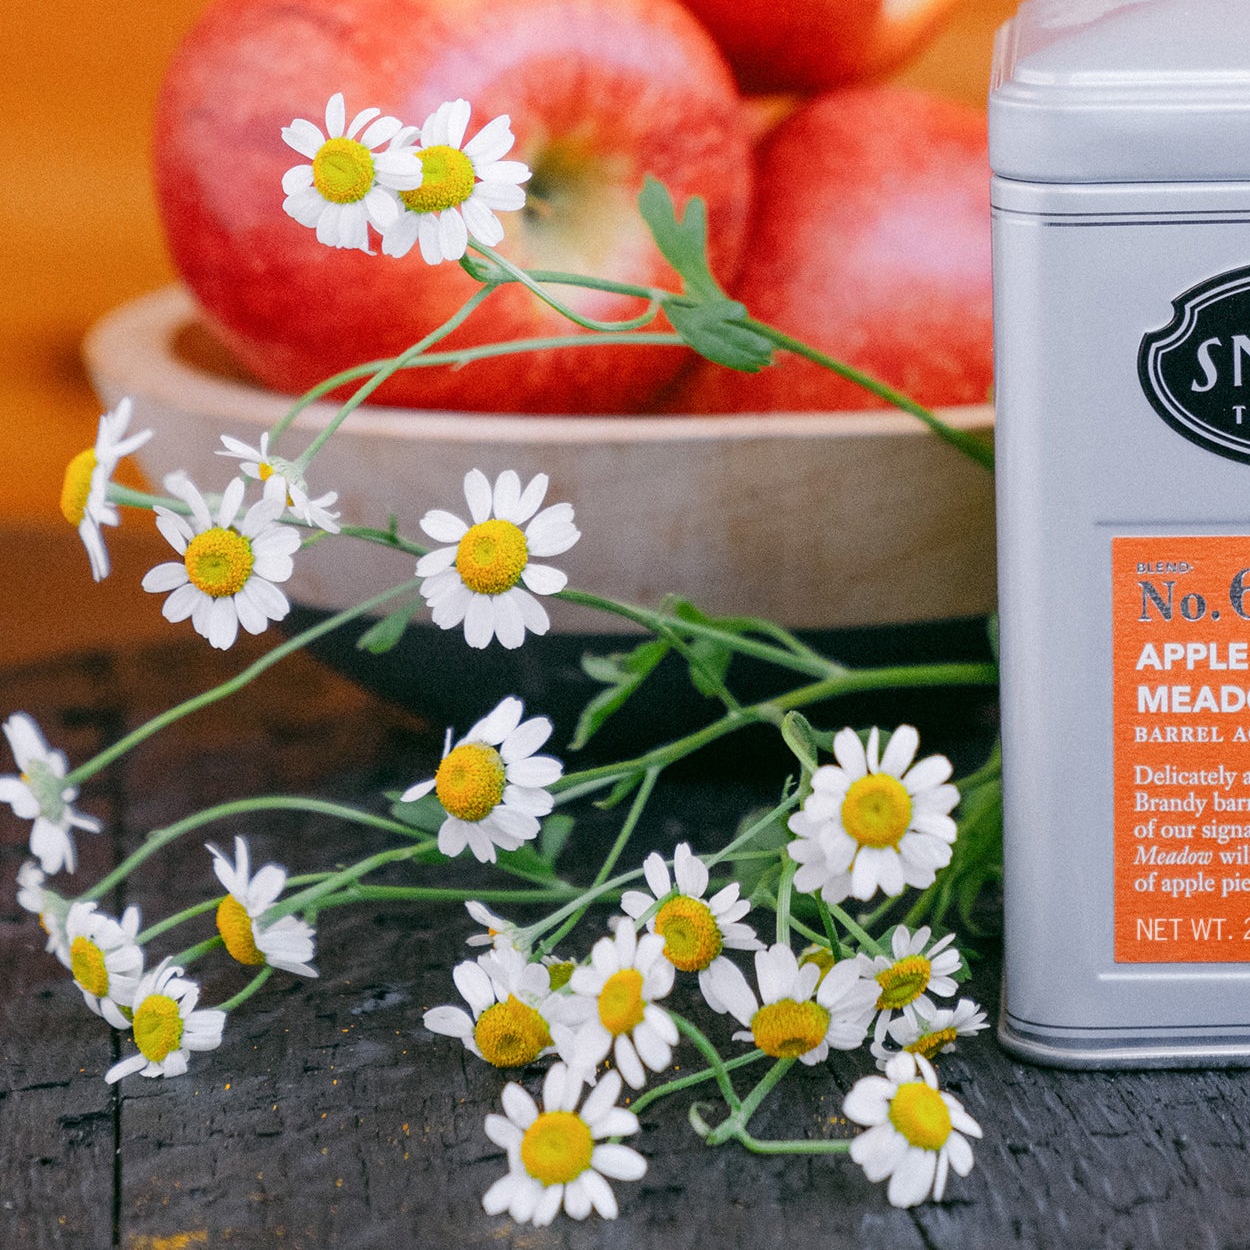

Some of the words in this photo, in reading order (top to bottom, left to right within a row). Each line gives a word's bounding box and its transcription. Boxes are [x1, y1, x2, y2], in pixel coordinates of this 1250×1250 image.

[1137, 580, 1221, 623] No.
[1135, 641, 1249, 671] APPLE
[1134, 726, 1224, 743] BARREL
[1134, 765, 1238, 790] Delicately
[1134, 792, 1207, 817] Brandy
[1133, 818, 1156, 839] of
[1160, 821, 1196, 839] our
[1133, 846, 1213, 866] Meadow
[1133, 872, 1157, 893] of
[1161, 872, 1215, 897] apple
[1136, 918, 1183, 941] NET
[1190, 917, 1234, 940] WT.
